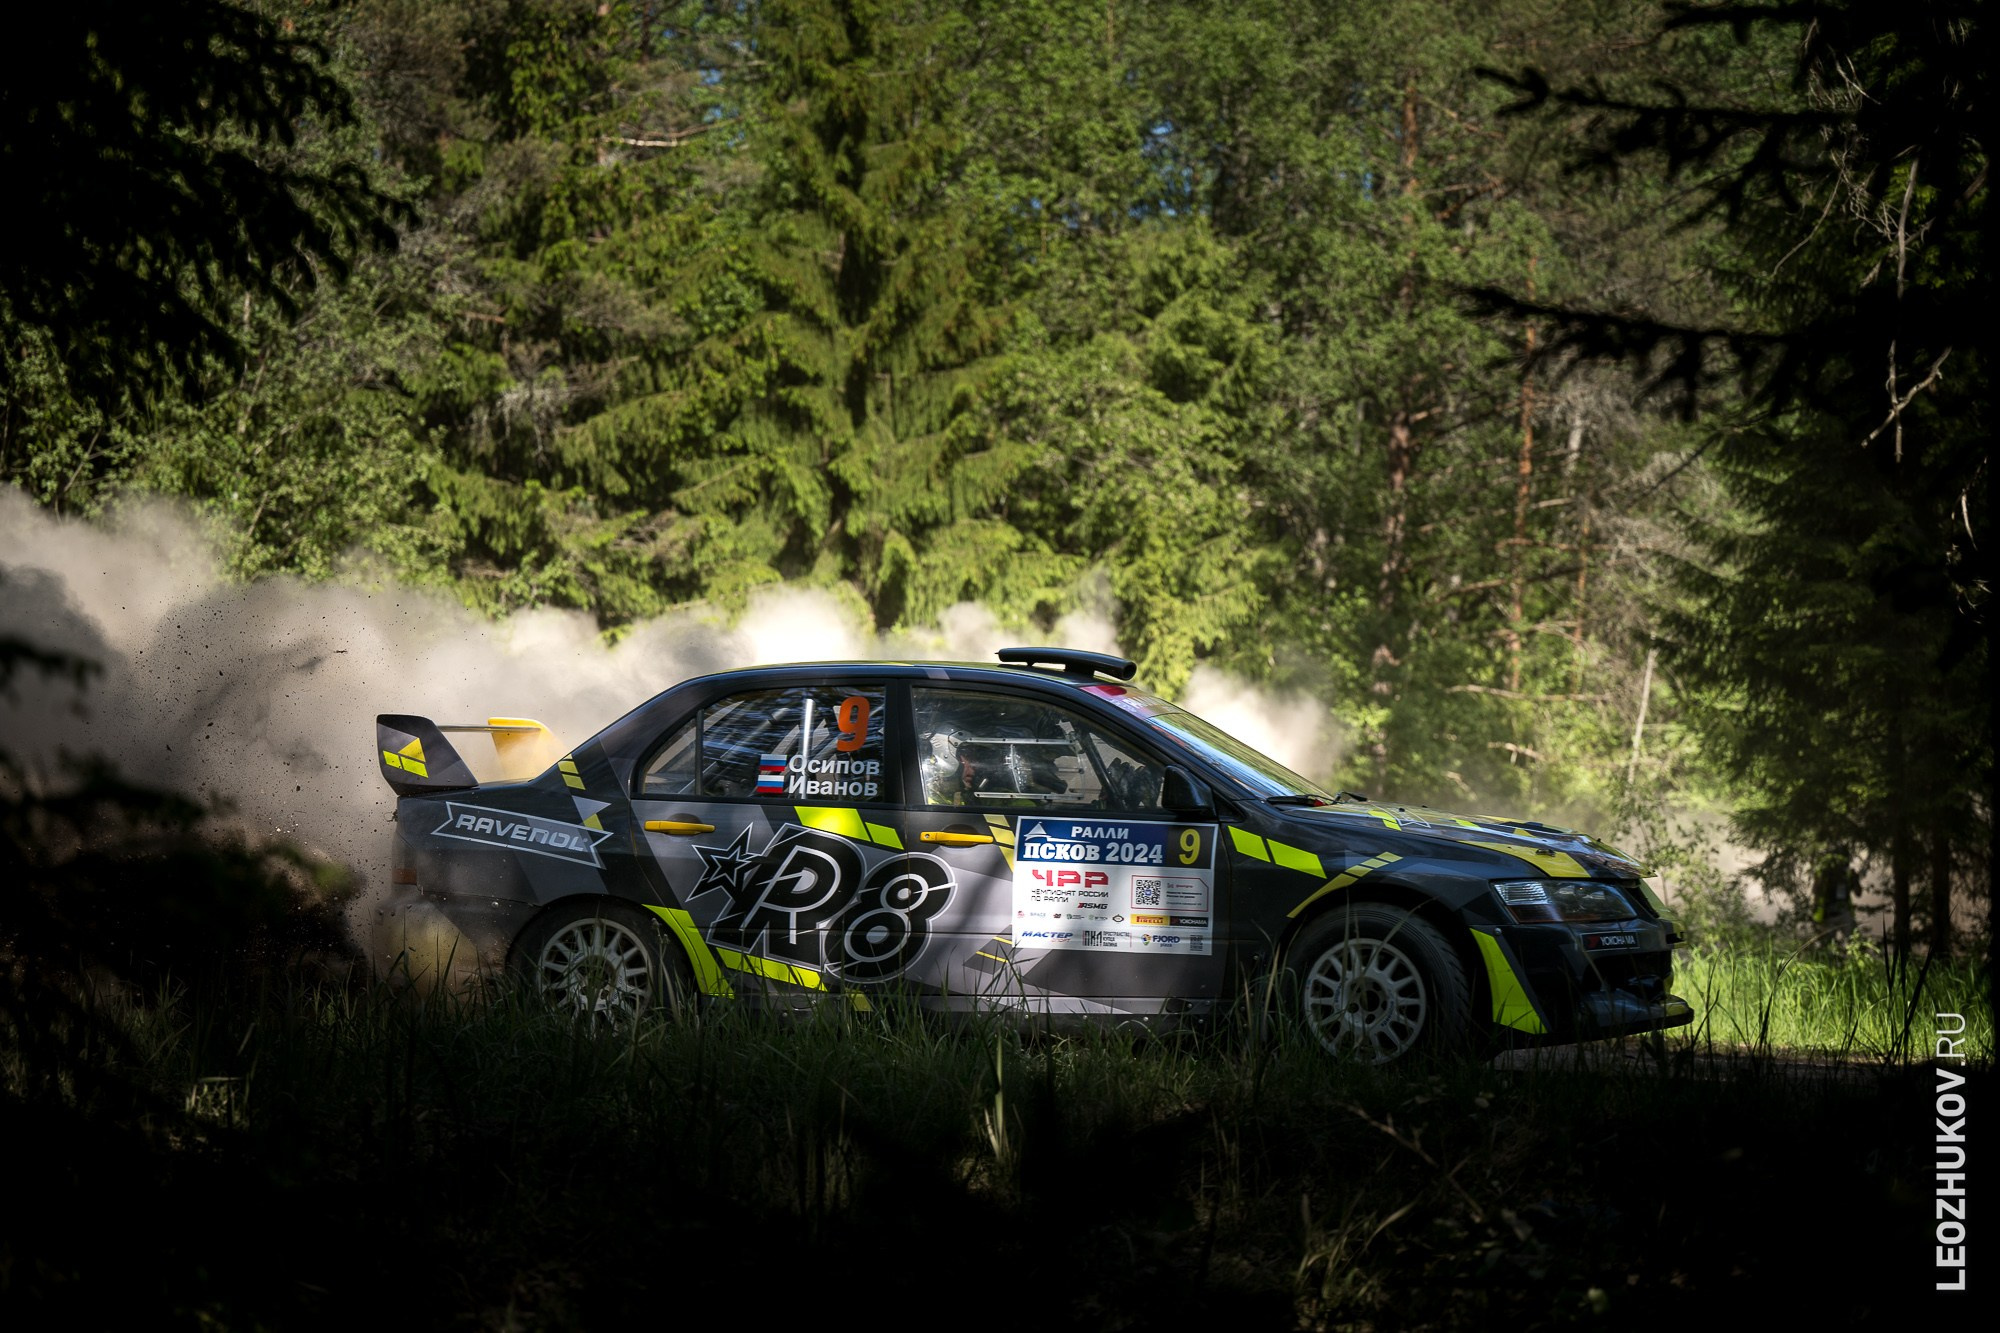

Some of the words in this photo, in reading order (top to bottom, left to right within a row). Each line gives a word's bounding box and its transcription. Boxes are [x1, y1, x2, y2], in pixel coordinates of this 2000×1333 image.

[835, 696, 871, 753] 9
[788, 754, 880, 776] Осипов
[787, 776, 879, 797] Иванов
[455, 813, 585, 852] RAVENOL
[1071, 826, 1129, 840] РАЛЛИ
[1023, 841, 1100, 861] ПСКОВ
[1105, 842, 1163, 864] 2024
[1178, 828, 1201, 865] 9
[1032, 869, 1109, 888] ЧРР
[706, 821, 959, 983] R8
[1078, 890, 1109, 898] РОССИИ
[1136, 916, 1164, 924] PIRELLI
[1022, 931, 1074, 939] МАСТЕР
[1152, 935, 1180, 943] FJORD
